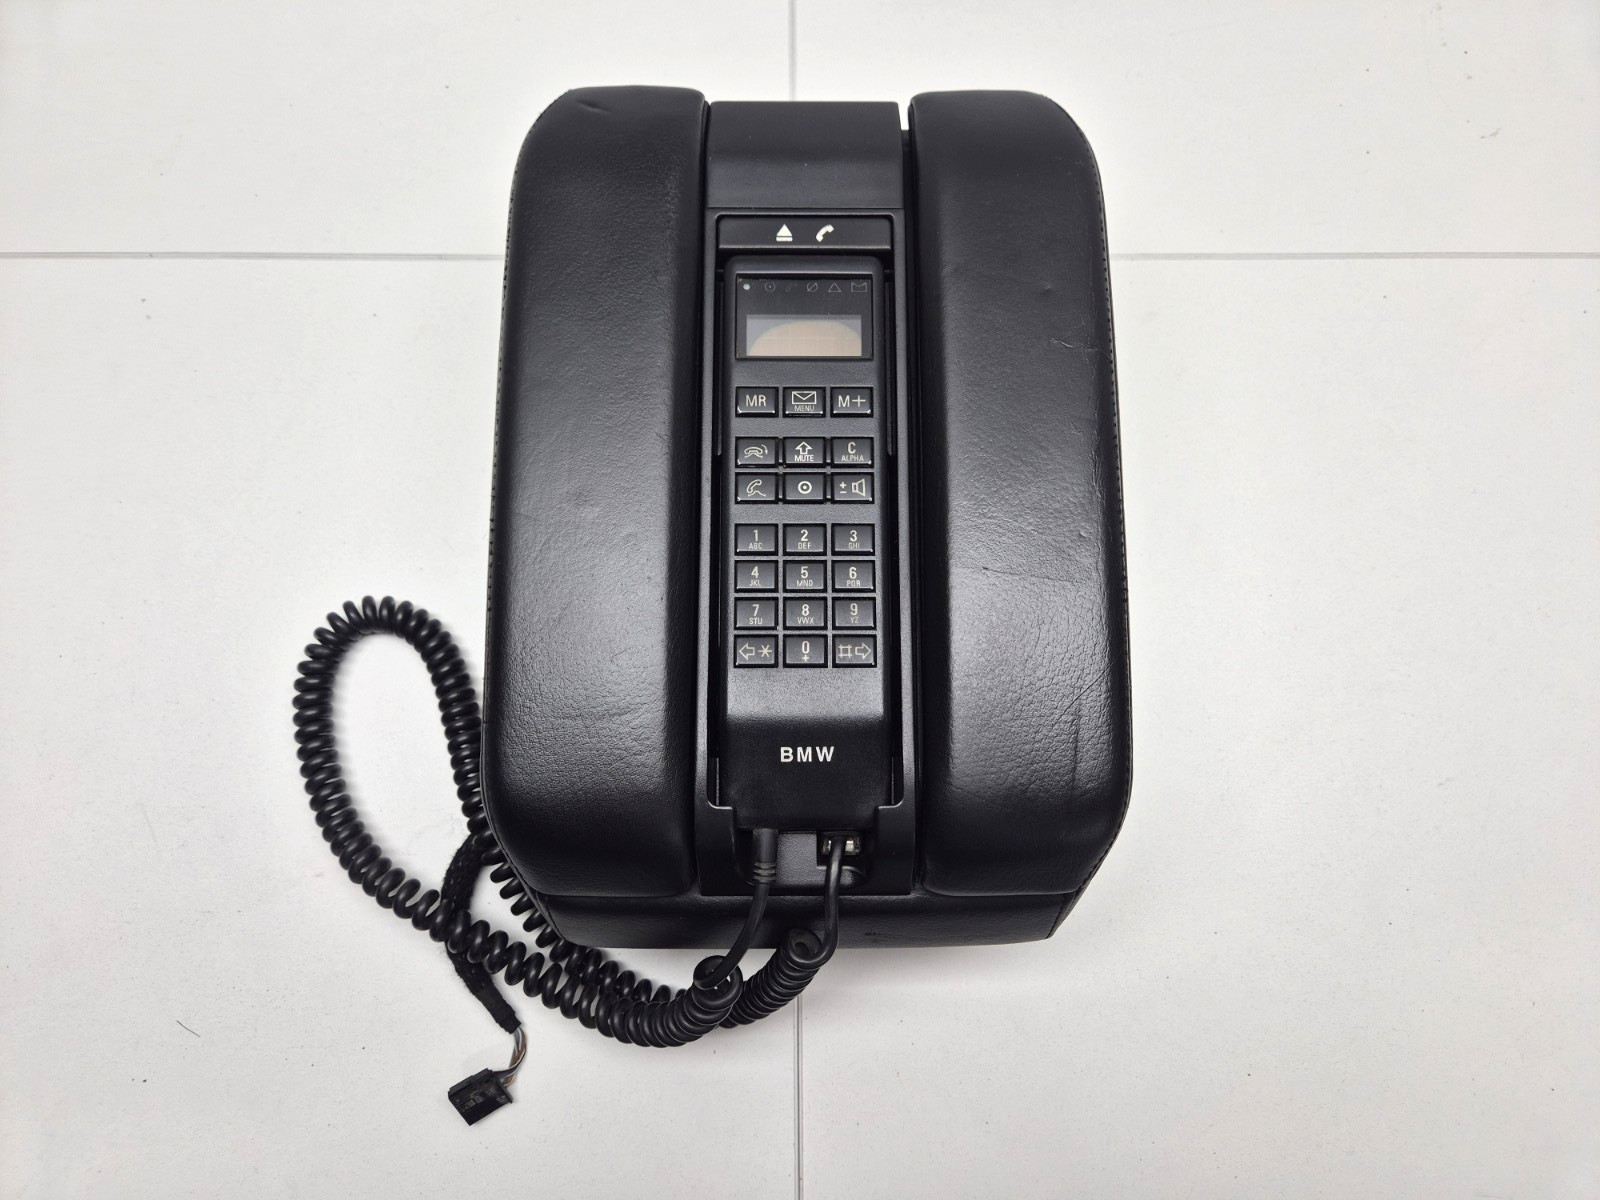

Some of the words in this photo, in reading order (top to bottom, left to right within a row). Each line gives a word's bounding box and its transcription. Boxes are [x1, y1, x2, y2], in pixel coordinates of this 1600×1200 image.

[746, 394, 766, 407] MR
[848, 442, 856, 454] C
[754, 530, 758, 541] 1
[800, 530, 808, 541] 2
[850, 530, 857, 542] 3
[751, 566, 759, 578] 4
[801, 566, 808, 578] 5
[849, 567, 857, 579] 6
[752, 604, 759, 616] 7
[802, 604, 809, 616] 8
[850, 603, 858, 615] 9
[802, 641, 810, 653] 0
[780, 746, 834, 762] BMW
